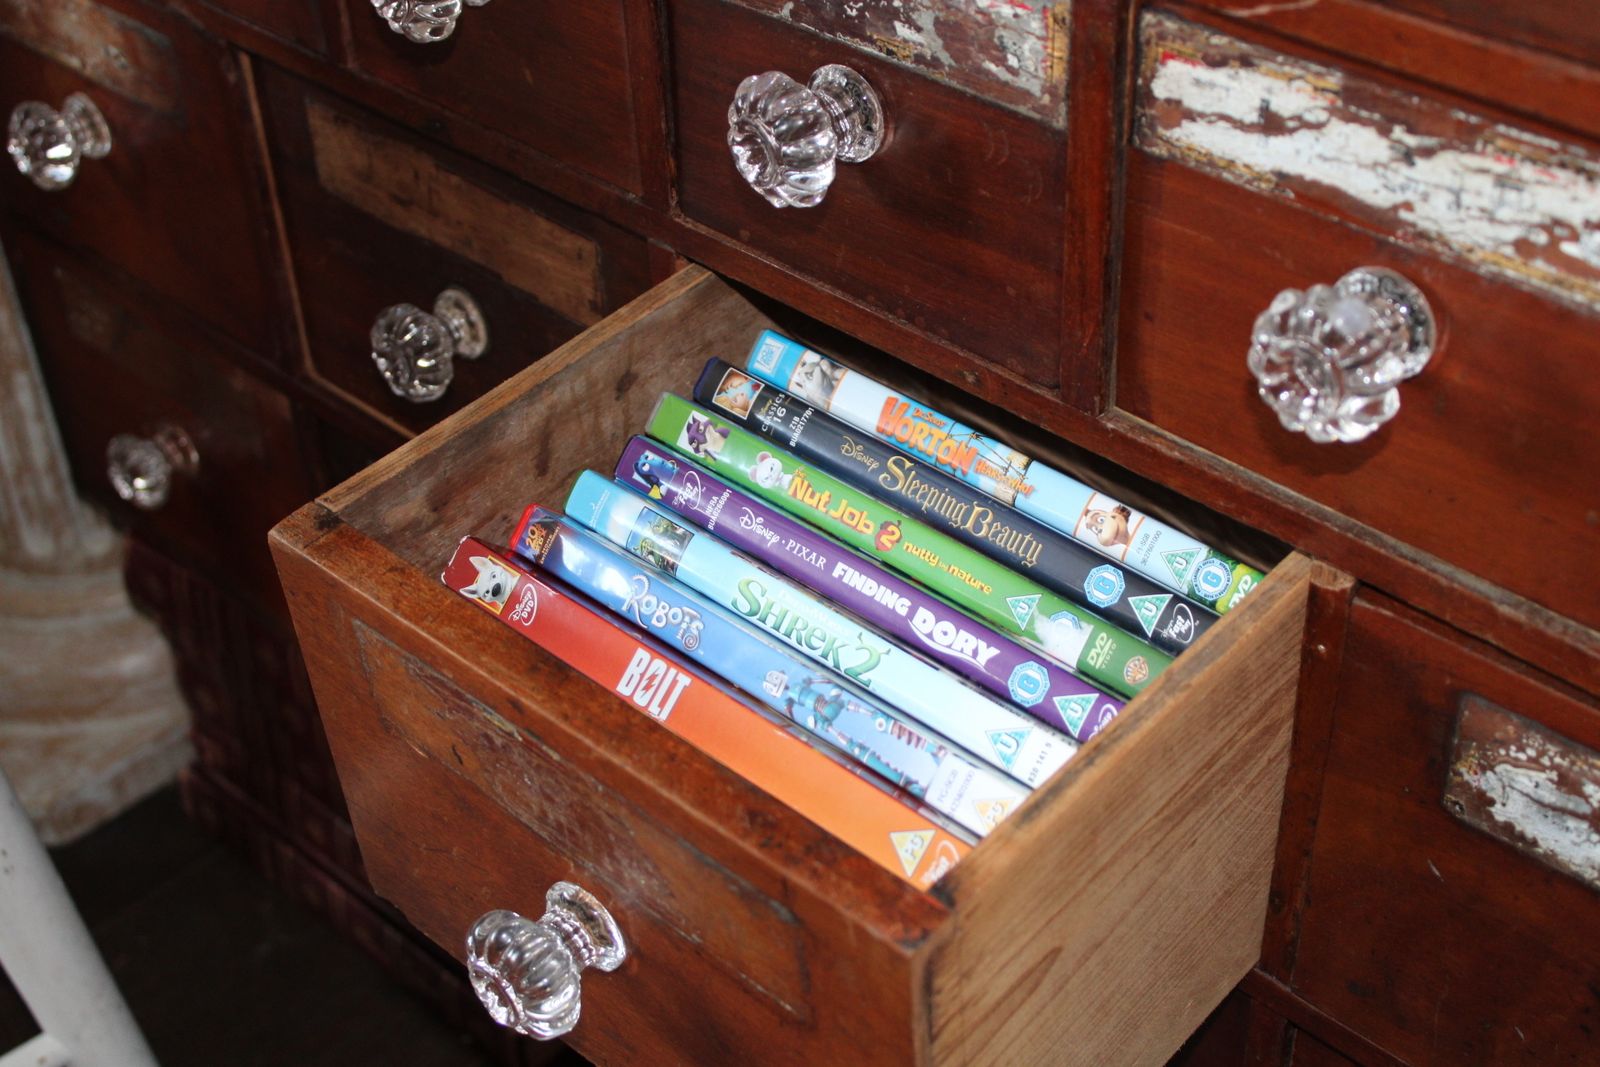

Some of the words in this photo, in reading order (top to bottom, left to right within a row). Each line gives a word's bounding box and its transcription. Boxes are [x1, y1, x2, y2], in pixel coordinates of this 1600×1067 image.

[762, 393, 785, 431] CLASSICS
[773, 406, 787, 423] 16
[789, 407, 815, 447] BUA0217701
[876, 396, 978, 475] HORTON
[788, 476, 832, 512] Nut
[829, 499, 874, 535] Job
[880, 525, 901, 549] 2
[878, 455, 970, 530] Sleeping
[960, 501, 1043, 568] Beauty
[903, 541, 938, 567] nutty
[947, 564, 993, 595] nature
[1173, 555, 1188, 569] U
[508, 590, 533, 621] Disney
[521, 599, 535, 619] DVD
[622, 574, 705, 650] ROBOTS
[785, 539, 827, 570] PIXAR
[832, 561, 912, 616] FINDING
[912, 606, 1000, 667] DORY
[1016, 602, 1030, 613] U
[1141, 601, 1158, 616] U
[731, 578, 848, 672] SHREK
[844, 632, 891, 688] 2
[1087, 632, 1108, 666] DVD
[1101, 643, 1117, 669] VIDEO
[616, 648, 692, 721] BOLT
[1066, 702, 1084, 717] U
[998, 732, 1020, 752] U
[904, 835, 925, 861] PG
